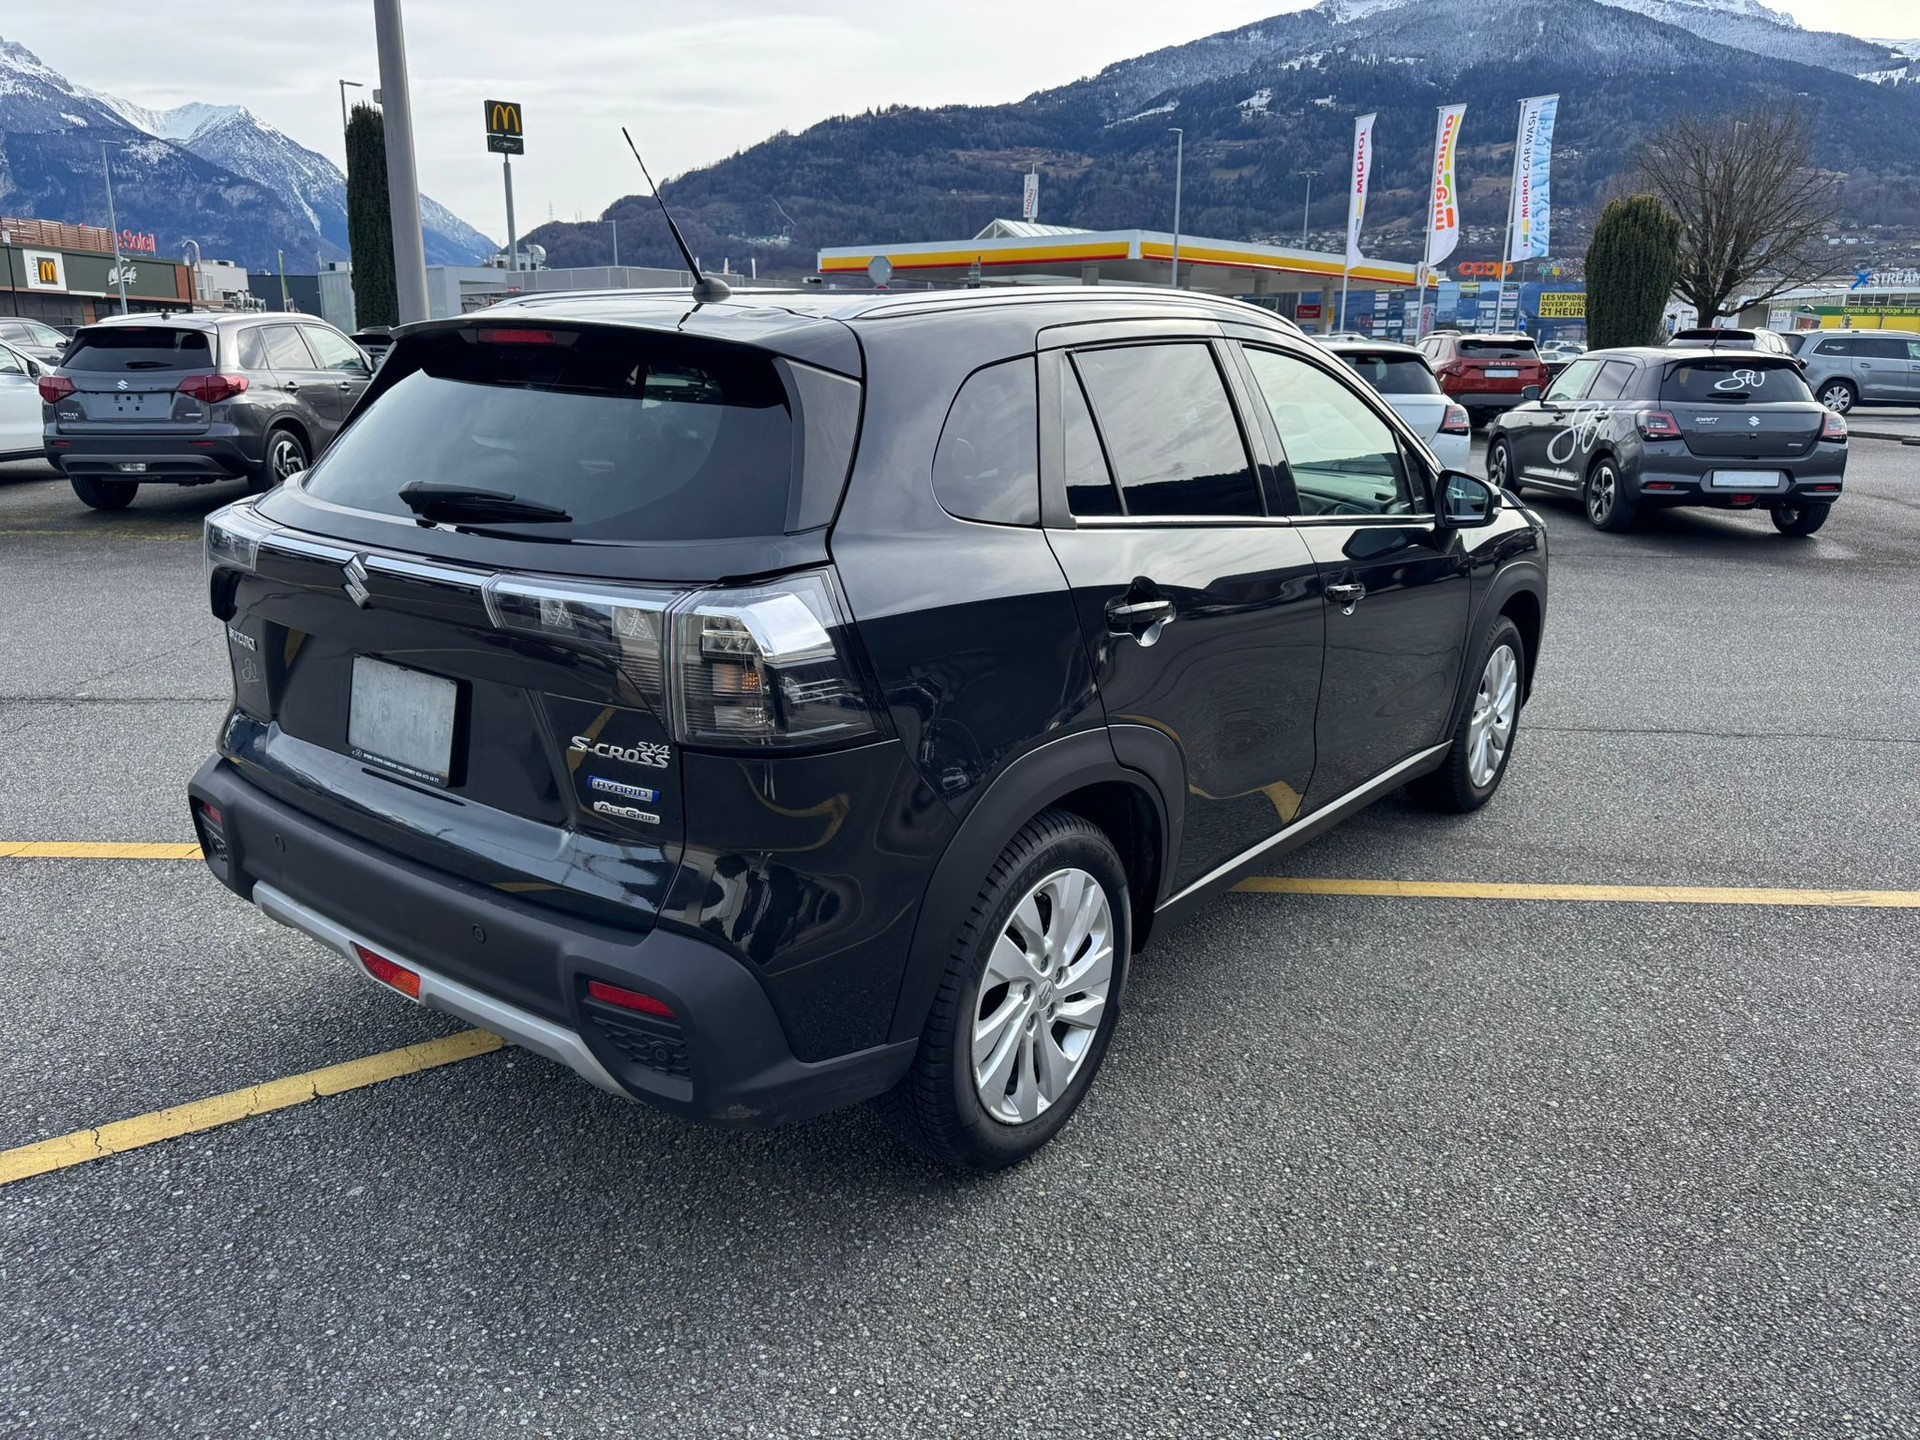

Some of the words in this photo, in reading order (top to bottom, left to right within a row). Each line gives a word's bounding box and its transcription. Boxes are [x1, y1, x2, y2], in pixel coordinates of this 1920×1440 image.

[1525, 110, 1538, 147] WASH
[1356, 128, 1367, 194] MIGROL
[1523, 147, 1532, 171] CAR
[1436, 114, 1454, 231] migrolino
[1458, 262, 1513, 281] coop
[1540, 308, 1552, 316] 21
[569, 735, 670, 769] S-CROSS
[637, 741, 670, 755] SX4
[595, 780, 648, 799] HYBRID
